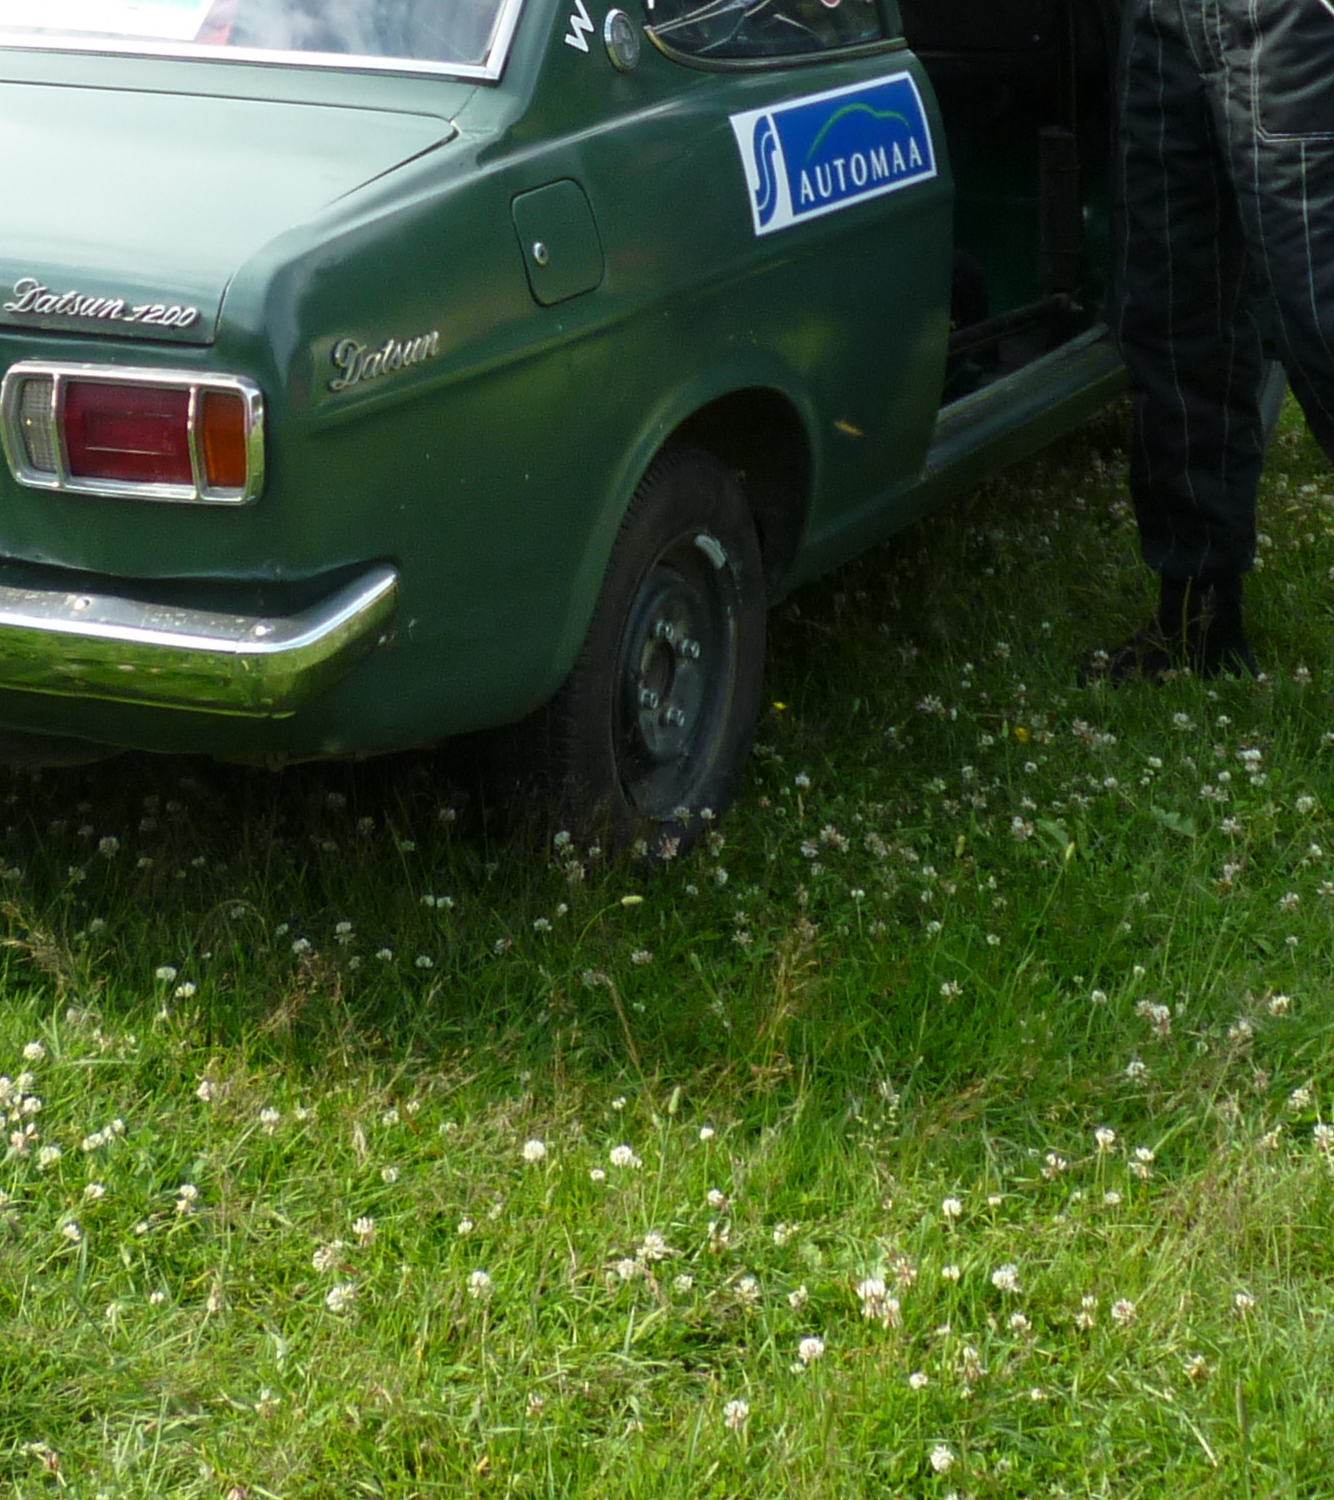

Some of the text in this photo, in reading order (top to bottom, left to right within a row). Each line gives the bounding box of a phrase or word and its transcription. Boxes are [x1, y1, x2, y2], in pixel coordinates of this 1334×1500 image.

[800, 136, 922, 204] AUTOMAA
[2, 277, 197, 327] Datsun 1200
[328, 327, 440, 392] Datsun
